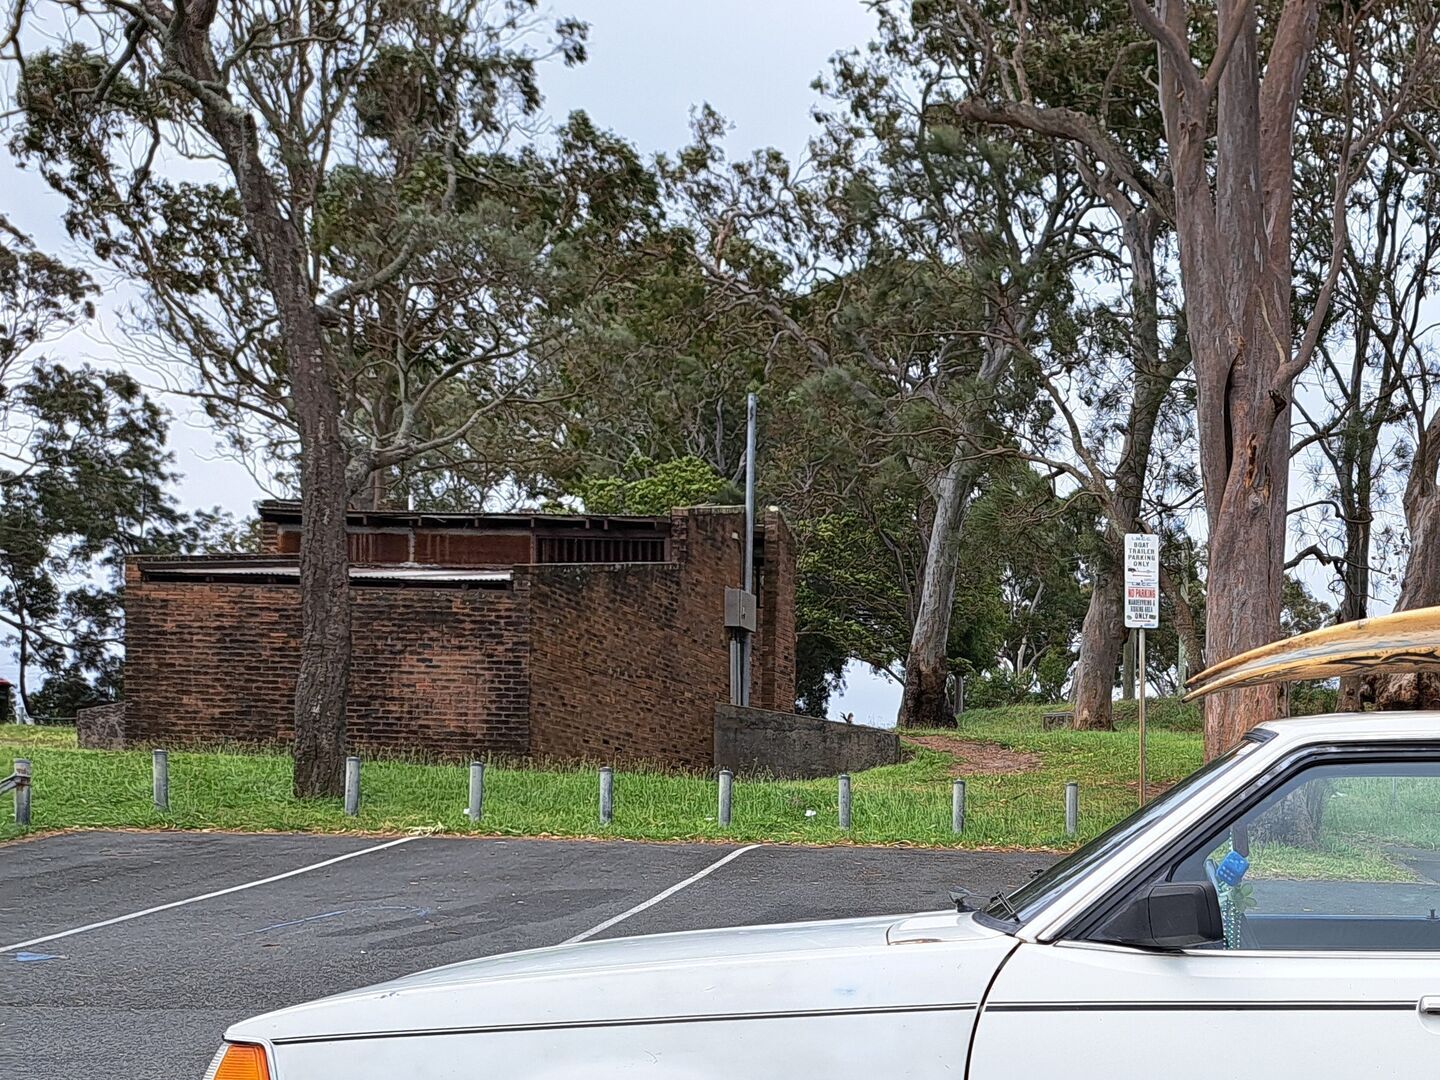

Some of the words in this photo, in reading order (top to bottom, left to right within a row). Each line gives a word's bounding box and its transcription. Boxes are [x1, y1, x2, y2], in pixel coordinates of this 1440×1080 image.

[1128, 588, 1134, 598] NO
[1135, 588, 1156, 599] PARKING
[1134, 612, 1149, 620] ONLY
